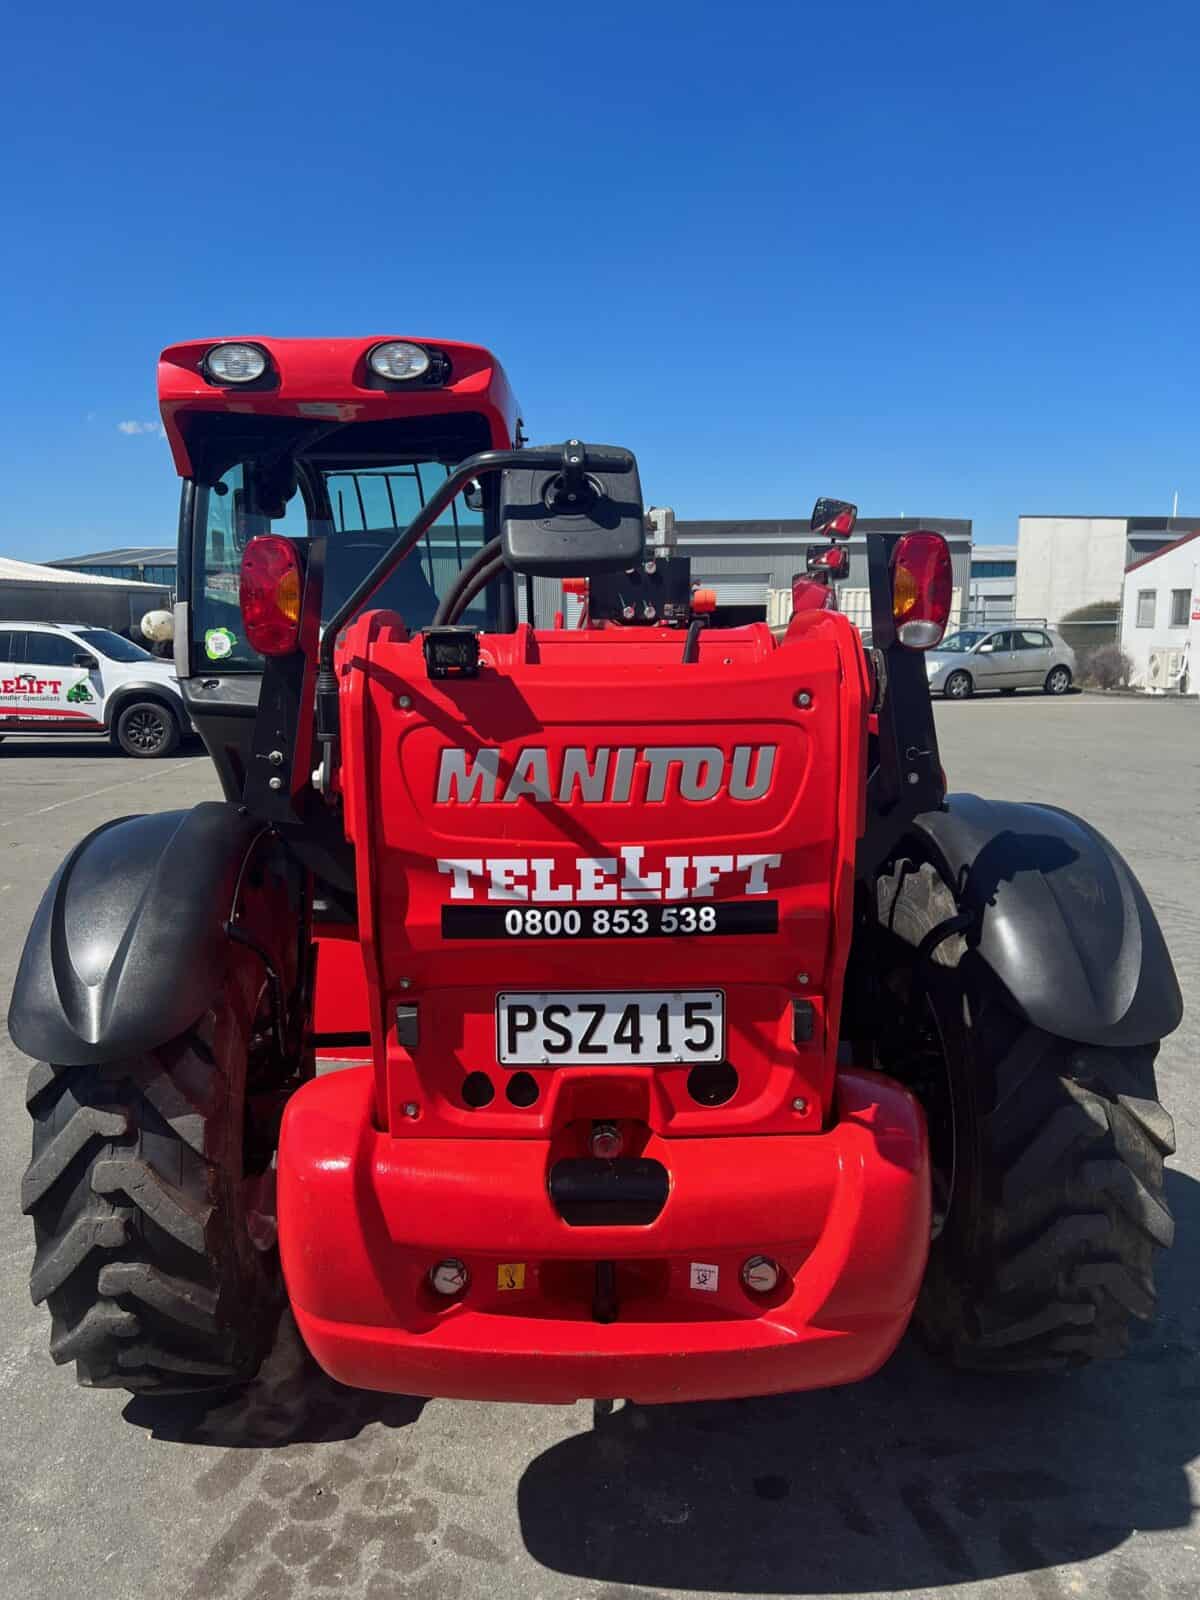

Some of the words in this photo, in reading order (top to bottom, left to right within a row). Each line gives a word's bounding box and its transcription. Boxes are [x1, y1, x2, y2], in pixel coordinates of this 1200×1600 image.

[0, 676, 62, 694] ELIFT
[435, 746, 778, 804] MANITOU
[437, 846, 782, 901] TELELIFT
[504, 909, 582, 936] 0800
[592, 908, 649, 935] 853
[660, 906, 717, 933] 538
[507, 1001, 715, 1055] PSZ415
